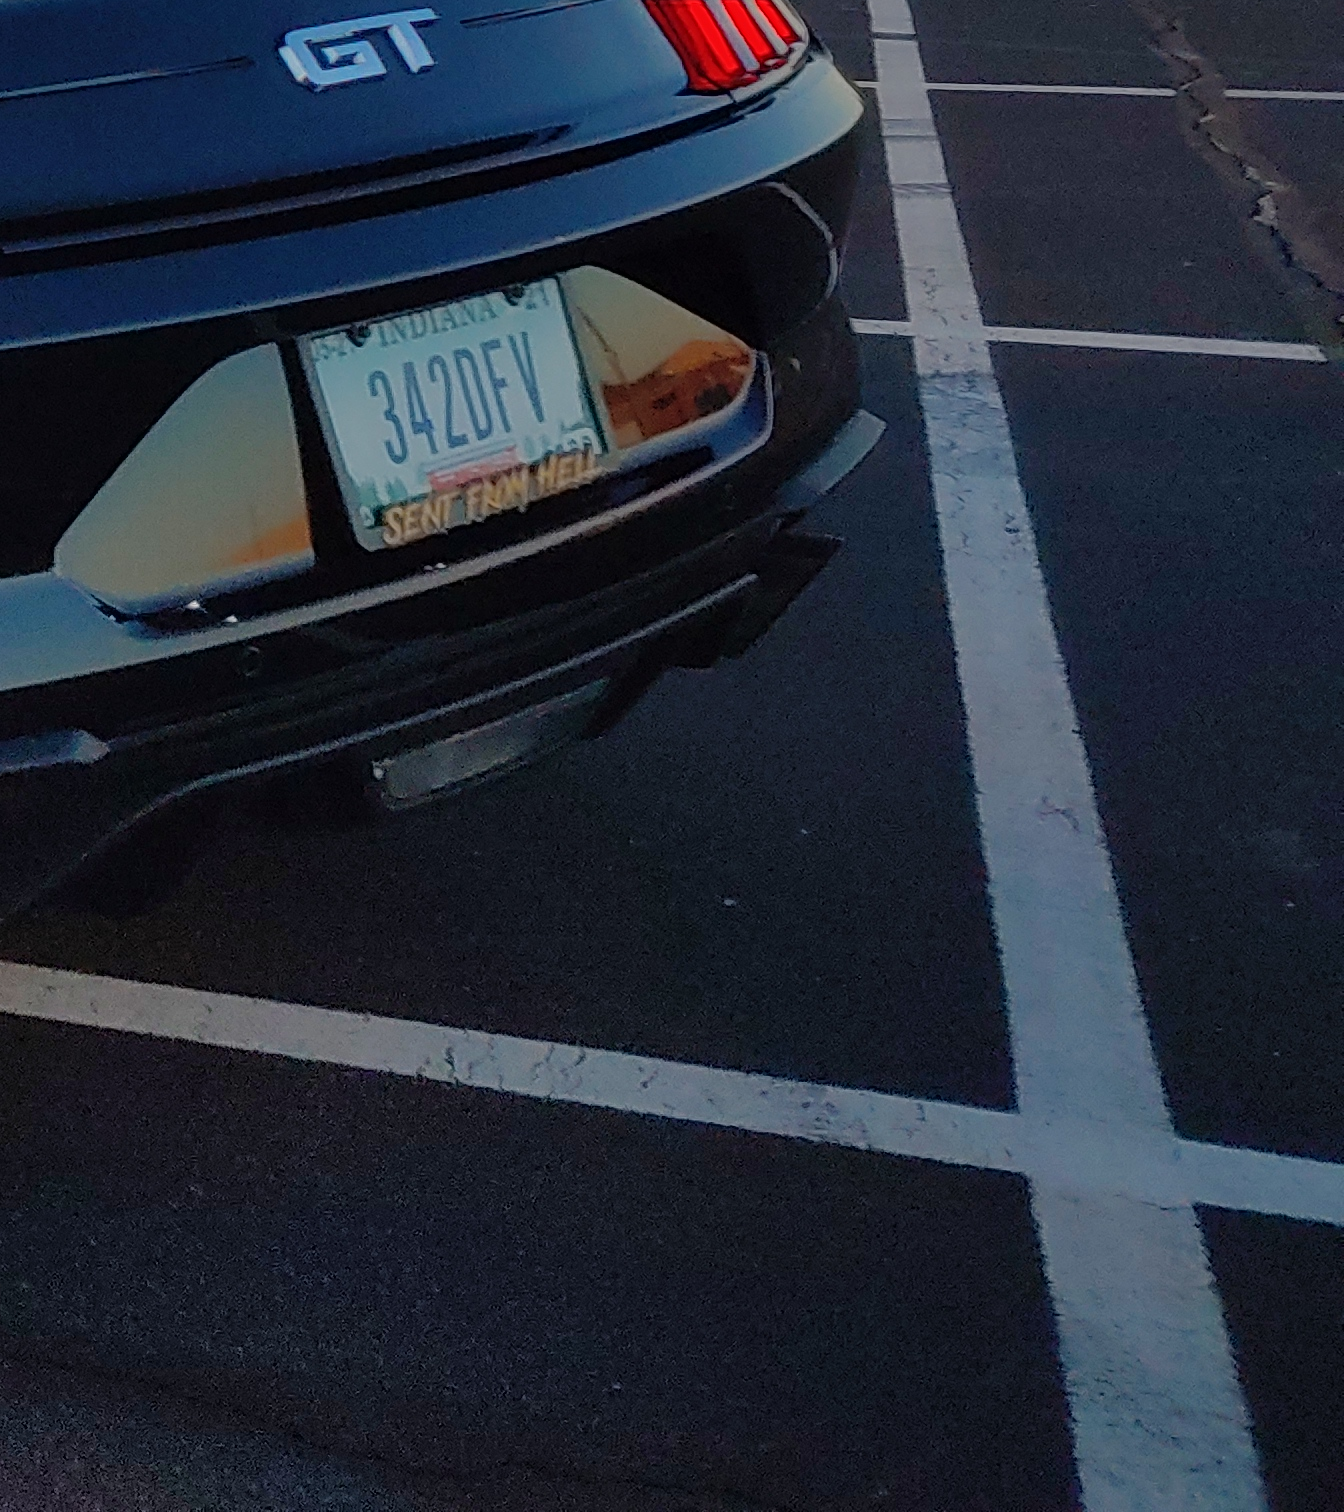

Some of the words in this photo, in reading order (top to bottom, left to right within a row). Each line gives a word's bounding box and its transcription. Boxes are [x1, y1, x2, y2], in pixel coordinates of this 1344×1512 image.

[278, 7, 442, 91] GT
[375, 294, 500, 348] INDIANA
[367, 331, 546, 465] 342DFV
[382, 489, 461, 546] SENT
